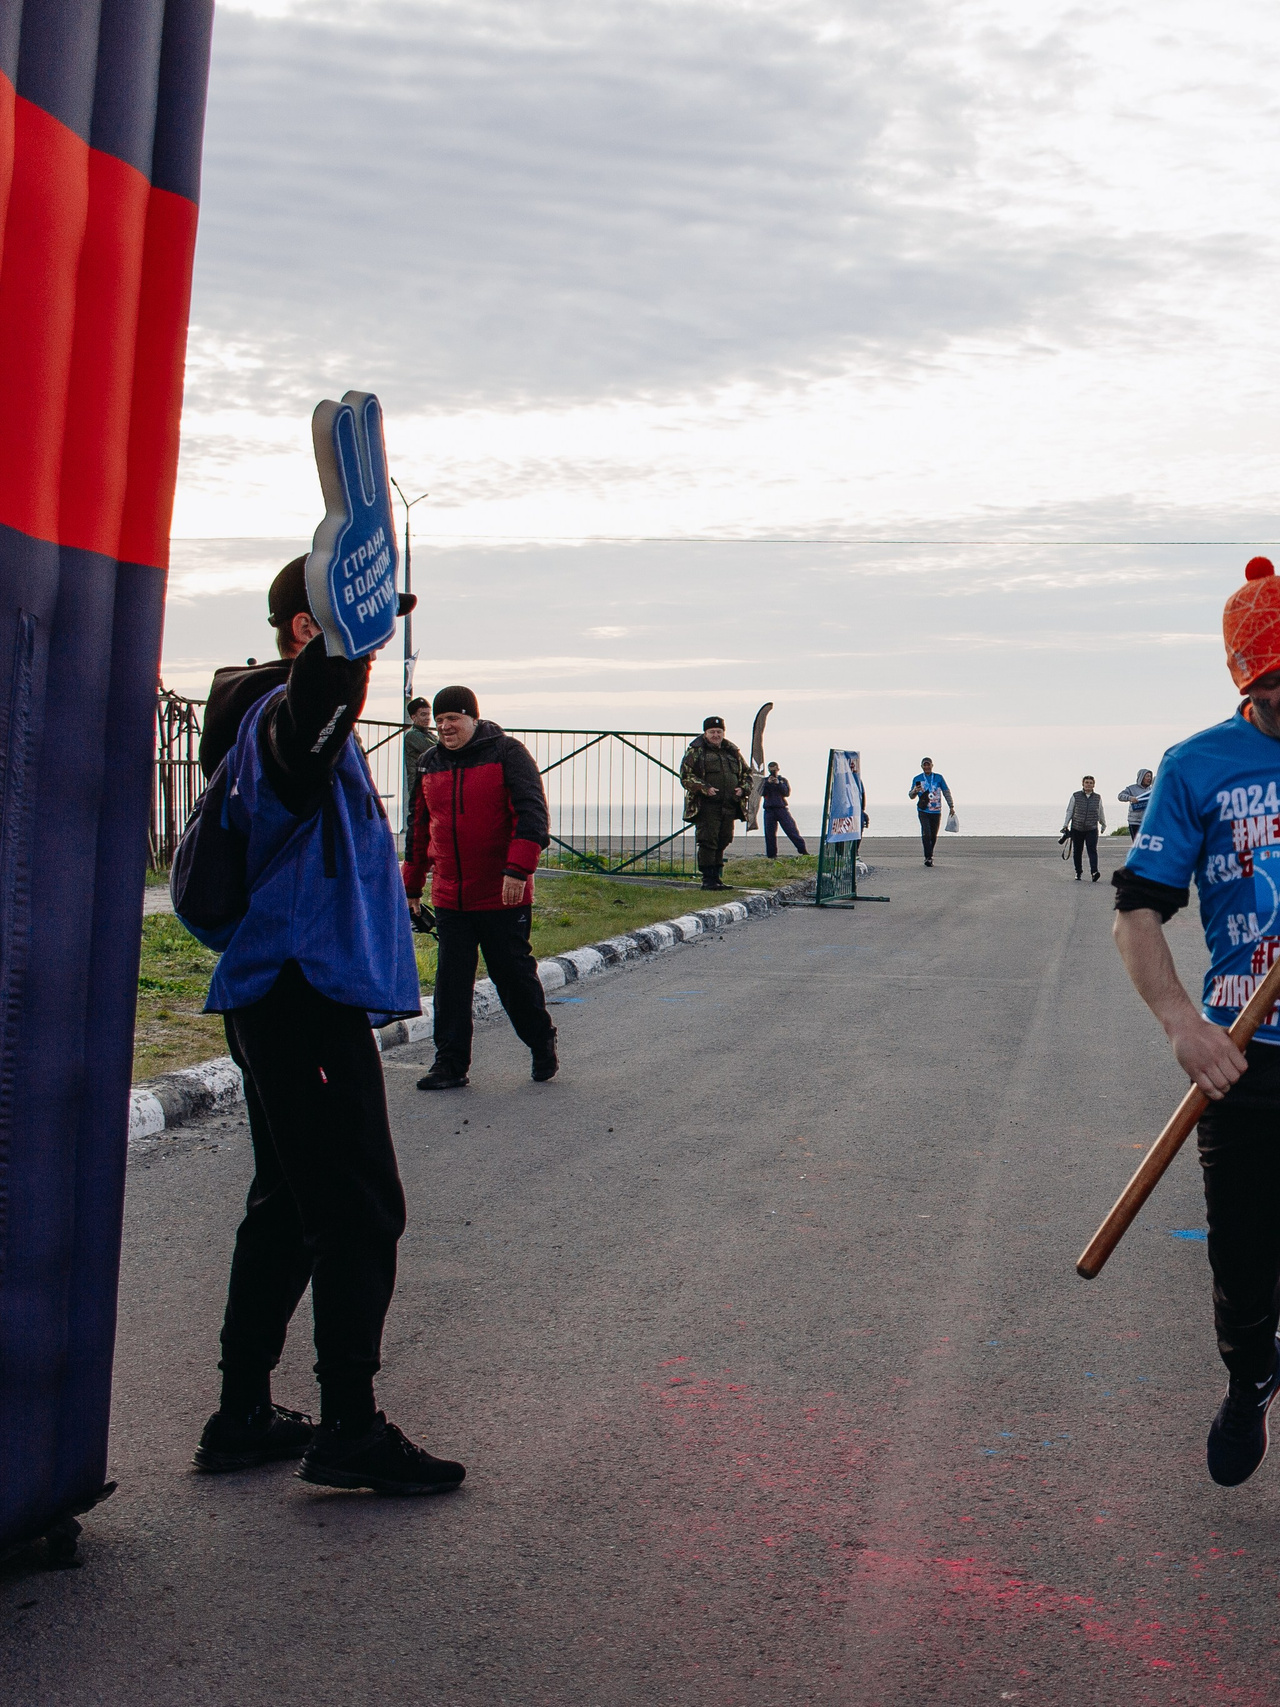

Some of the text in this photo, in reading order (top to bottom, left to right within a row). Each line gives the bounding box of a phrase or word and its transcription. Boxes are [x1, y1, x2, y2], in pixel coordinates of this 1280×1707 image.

[343, 527, 386, 579] СТРАНА
[344, 545, 391, 605] В ОДНОМ
[356, 574, 394, 624] РИТМЕ
[1217, 781, 1280, 821] 2024
